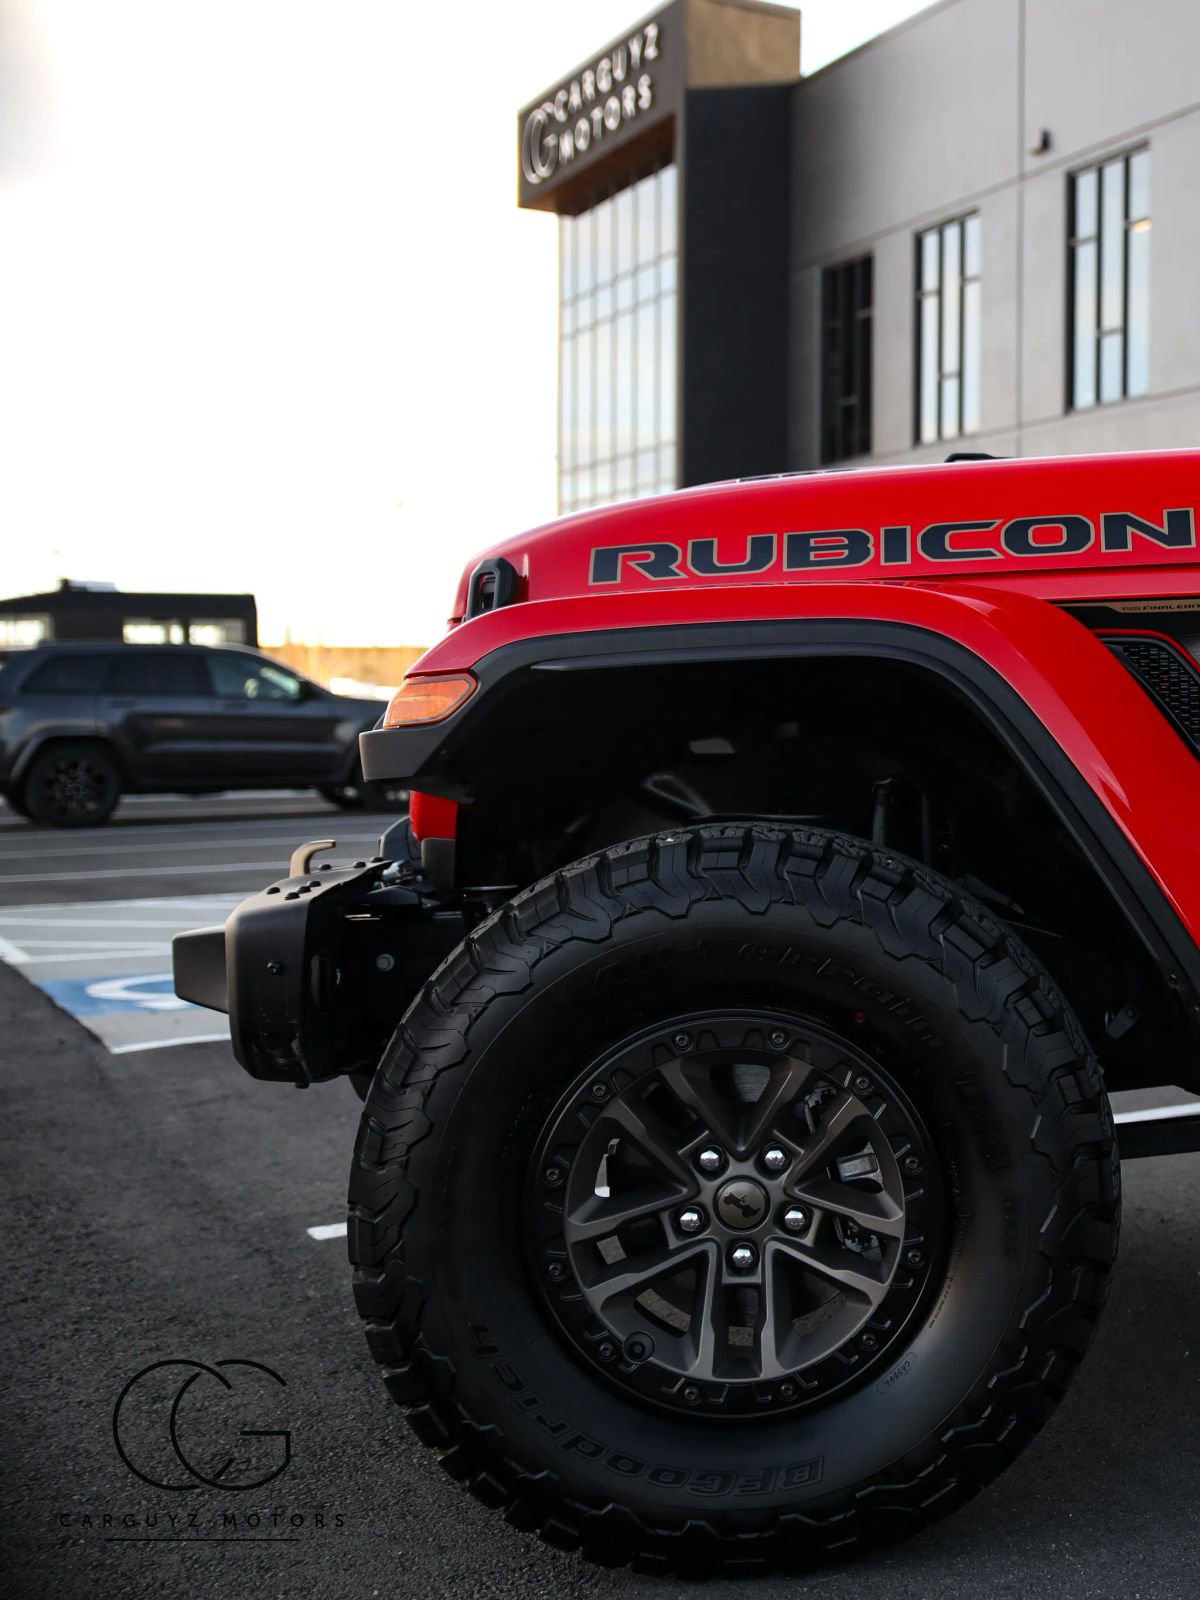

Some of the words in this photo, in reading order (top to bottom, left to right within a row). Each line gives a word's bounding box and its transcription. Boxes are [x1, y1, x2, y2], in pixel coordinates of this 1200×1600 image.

[553, 22, 659, 123] CARGUYZ
[558, 73, 652, 165] MOTORS
[586, 507, 1197, 586] RUBICON
[466, 1321, 826, 1497] BFGoodrich
